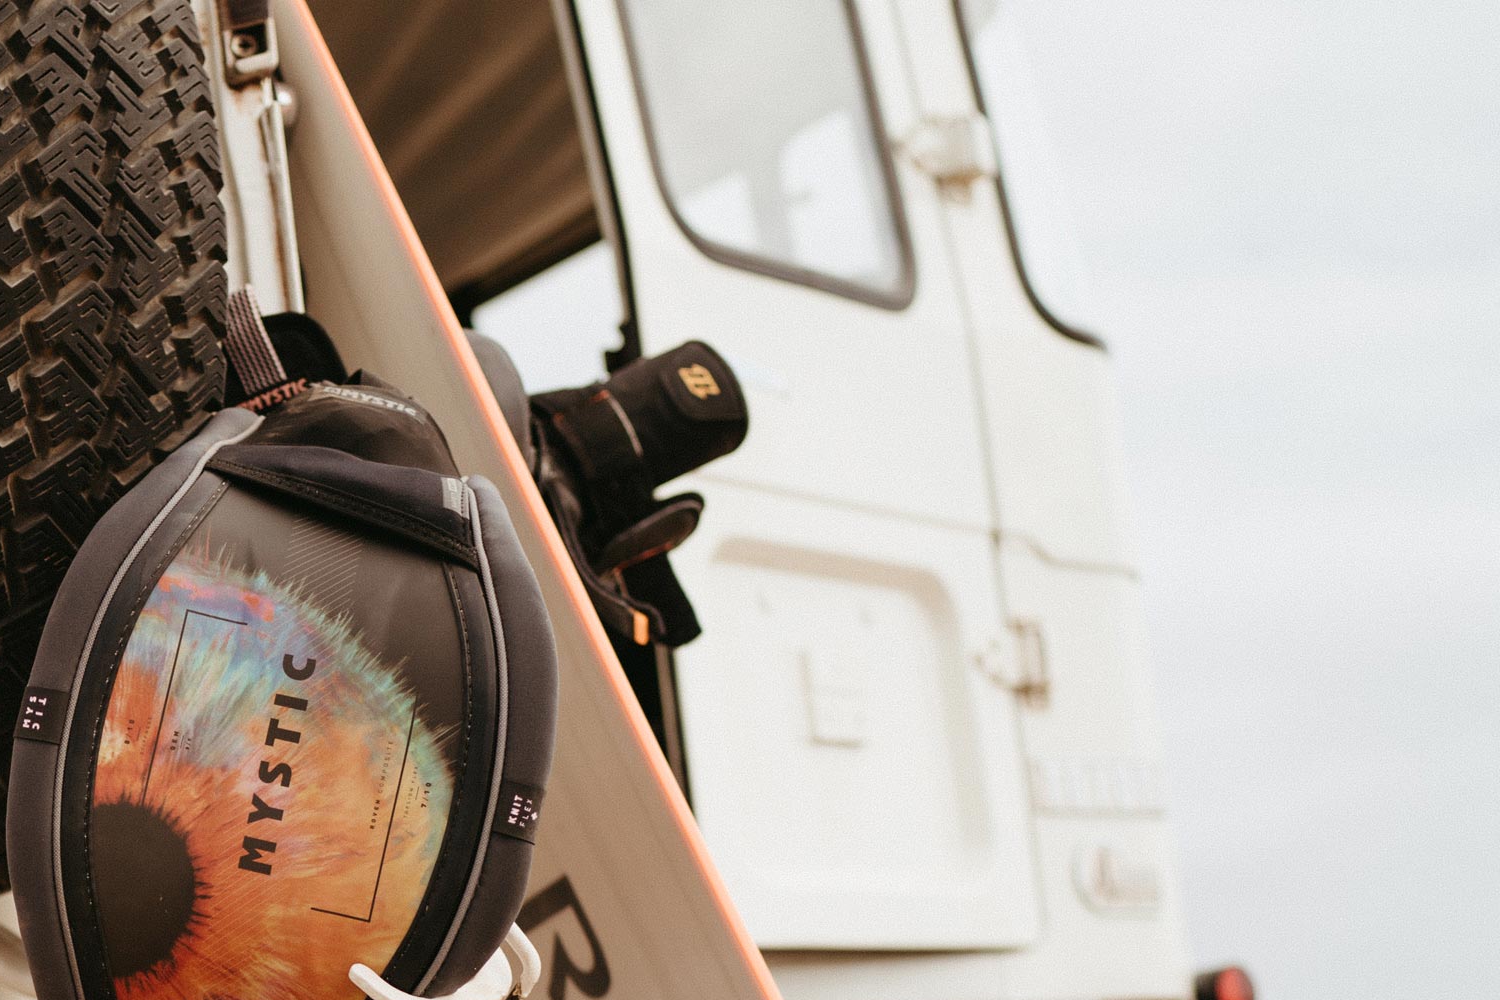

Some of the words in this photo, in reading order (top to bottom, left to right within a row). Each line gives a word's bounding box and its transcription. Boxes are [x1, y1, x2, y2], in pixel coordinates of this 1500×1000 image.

[248, 378, 309, 412] MYSTIC
[338, 388, 417, 417] MYSTIC
[238, 653, 317, 876] MYSTIC
[378, 741, 394, 794] COMPOSITE
[420, 782, 432, 808] 7/10
[508, 794, 523, 824] KNIT
[519, 798, 533, 828] FLEX
